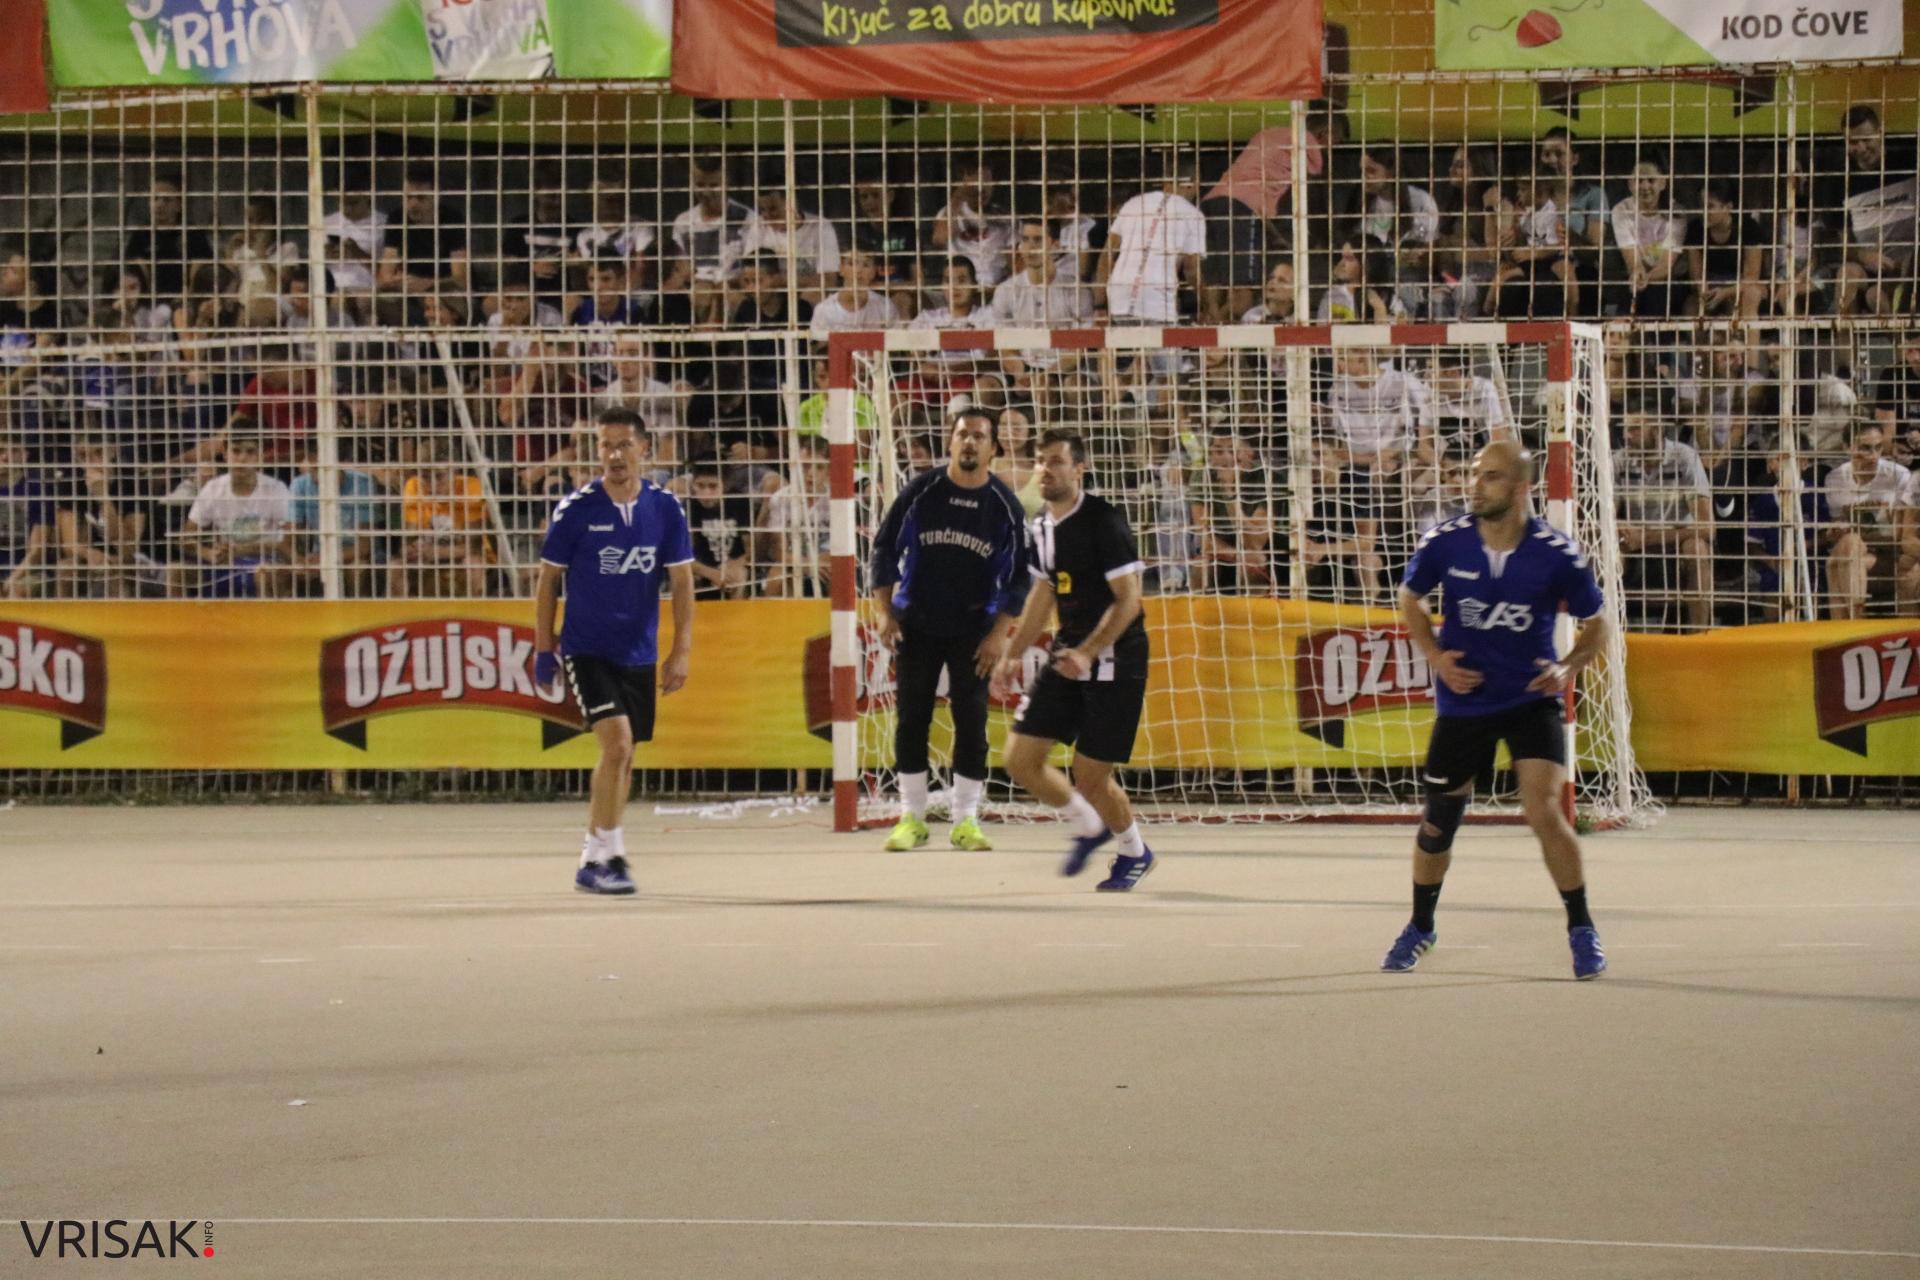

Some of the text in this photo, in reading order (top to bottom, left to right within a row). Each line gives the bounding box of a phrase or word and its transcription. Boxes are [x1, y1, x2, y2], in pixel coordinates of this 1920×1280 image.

[907, 5, 953, 32] za
[963, 0, 1041, 30] dobru
[1721, 6, 1869, 40] KOD ČOVE
[129, 1, 358, 76] VRHOVA
